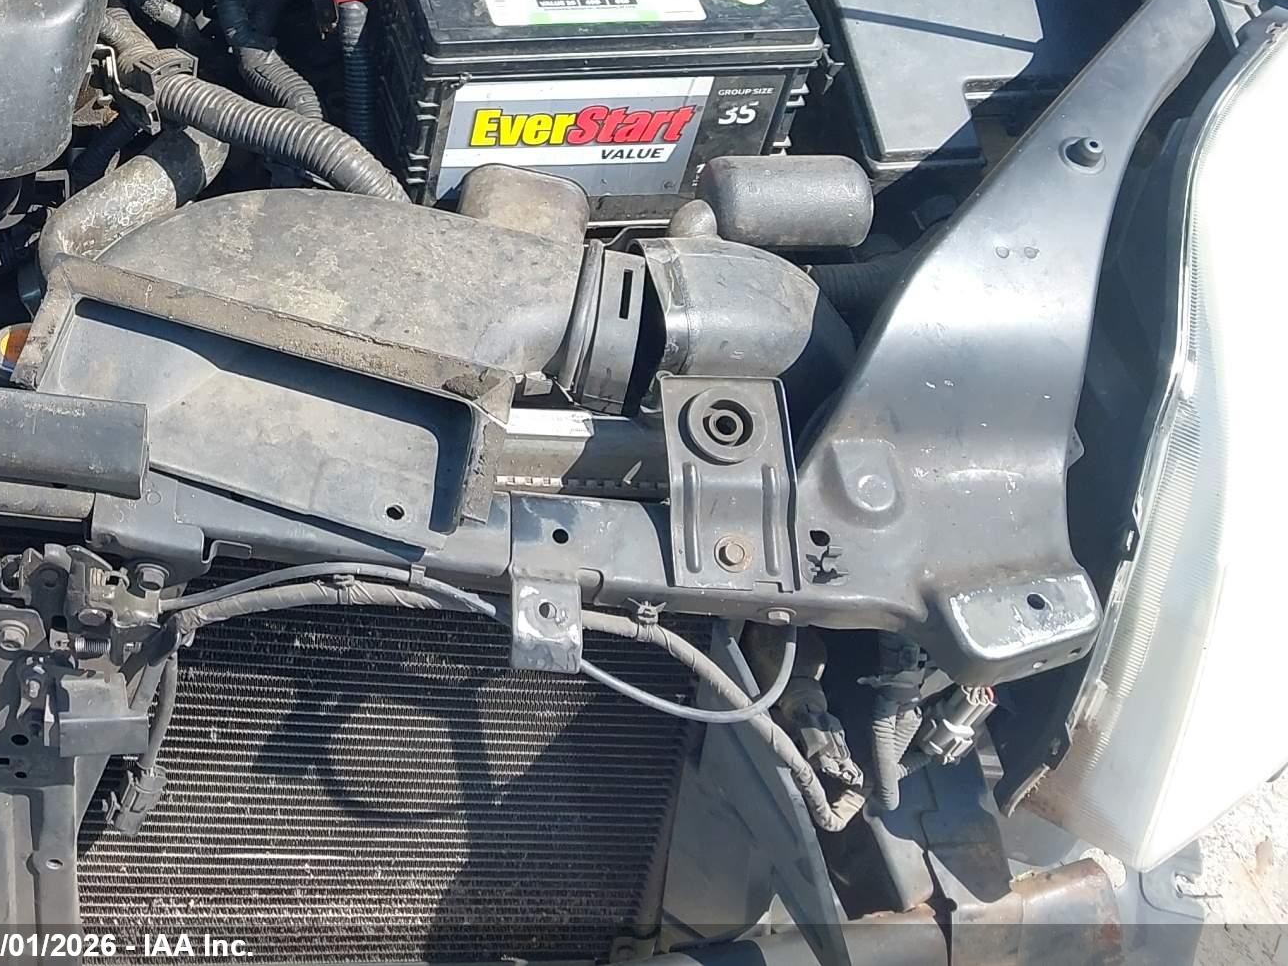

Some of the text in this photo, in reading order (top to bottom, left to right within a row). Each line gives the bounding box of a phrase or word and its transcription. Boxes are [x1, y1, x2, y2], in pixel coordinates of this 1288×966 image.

[753, 87, 774, 95] SIZE
[718, 100, 760, 125] 35
[470, 104, 698, 148] EverStart
[601, 147, 665, 161] VALUE
